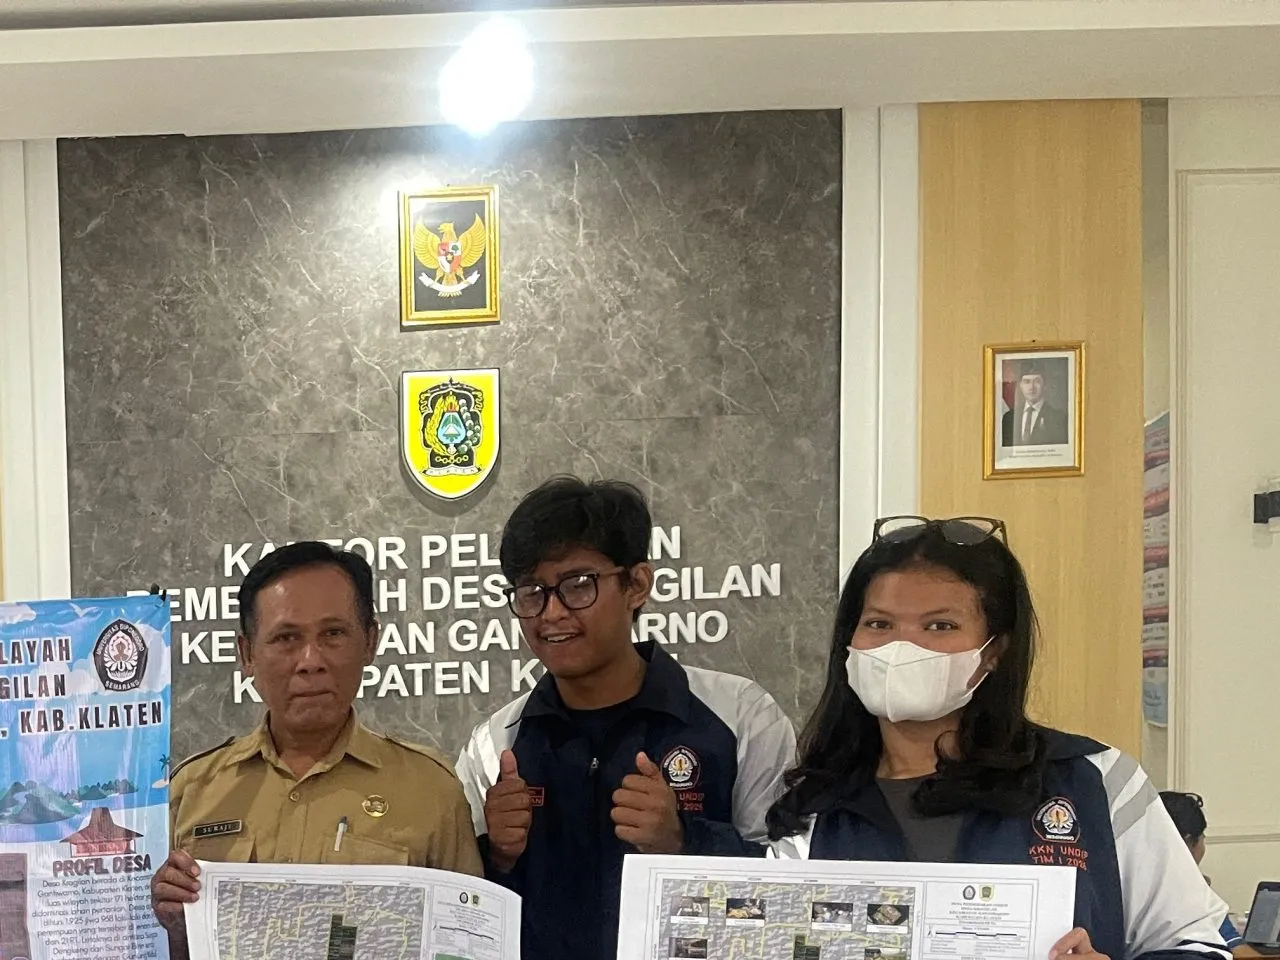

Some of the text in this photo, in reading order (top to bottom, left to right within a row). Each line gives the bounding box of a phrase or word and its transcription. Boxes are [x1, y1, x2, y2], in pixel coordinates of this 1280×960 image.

[422, 573, 515, 611] DES
[20, 700, 163, 734] KAB.KLATEN
[1029, 845, 1054, 855] KKN
[1032, 855, 1054, 864] TIM
[52, 854, 152, 878] PROFIL DESA
